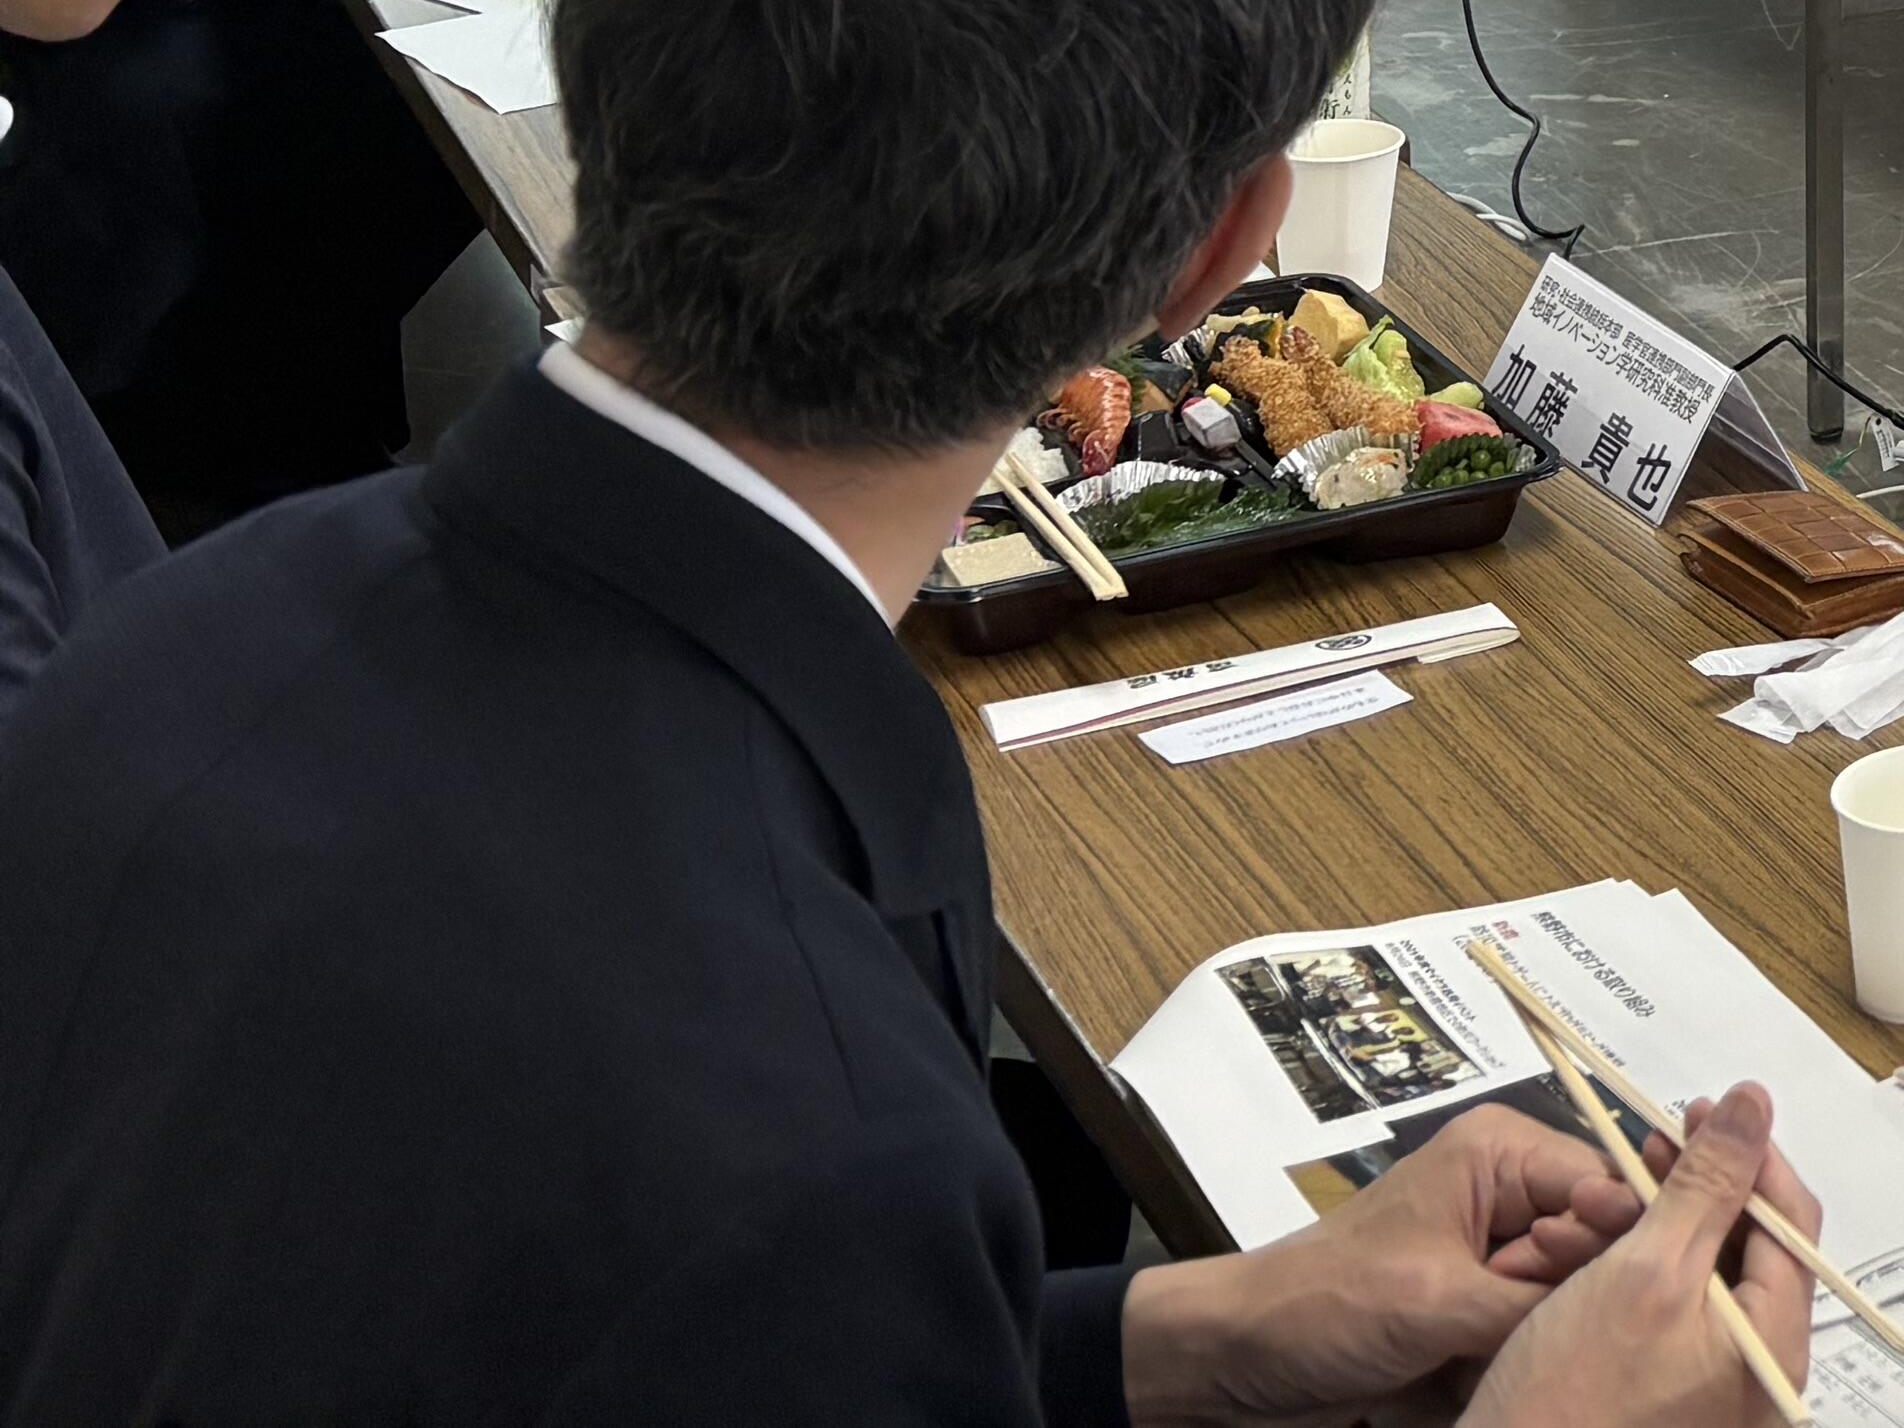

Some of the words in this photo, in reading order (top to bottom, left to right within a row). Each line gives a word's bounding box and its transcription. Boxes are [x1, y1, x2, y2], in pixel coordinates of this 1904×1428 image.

[1492, 343, 1579, 440] 加藤
[1580, 412, 1673, 512] 貴也
[1528, 293, 1704, 425] 地域イノベーション学研究科准教授
